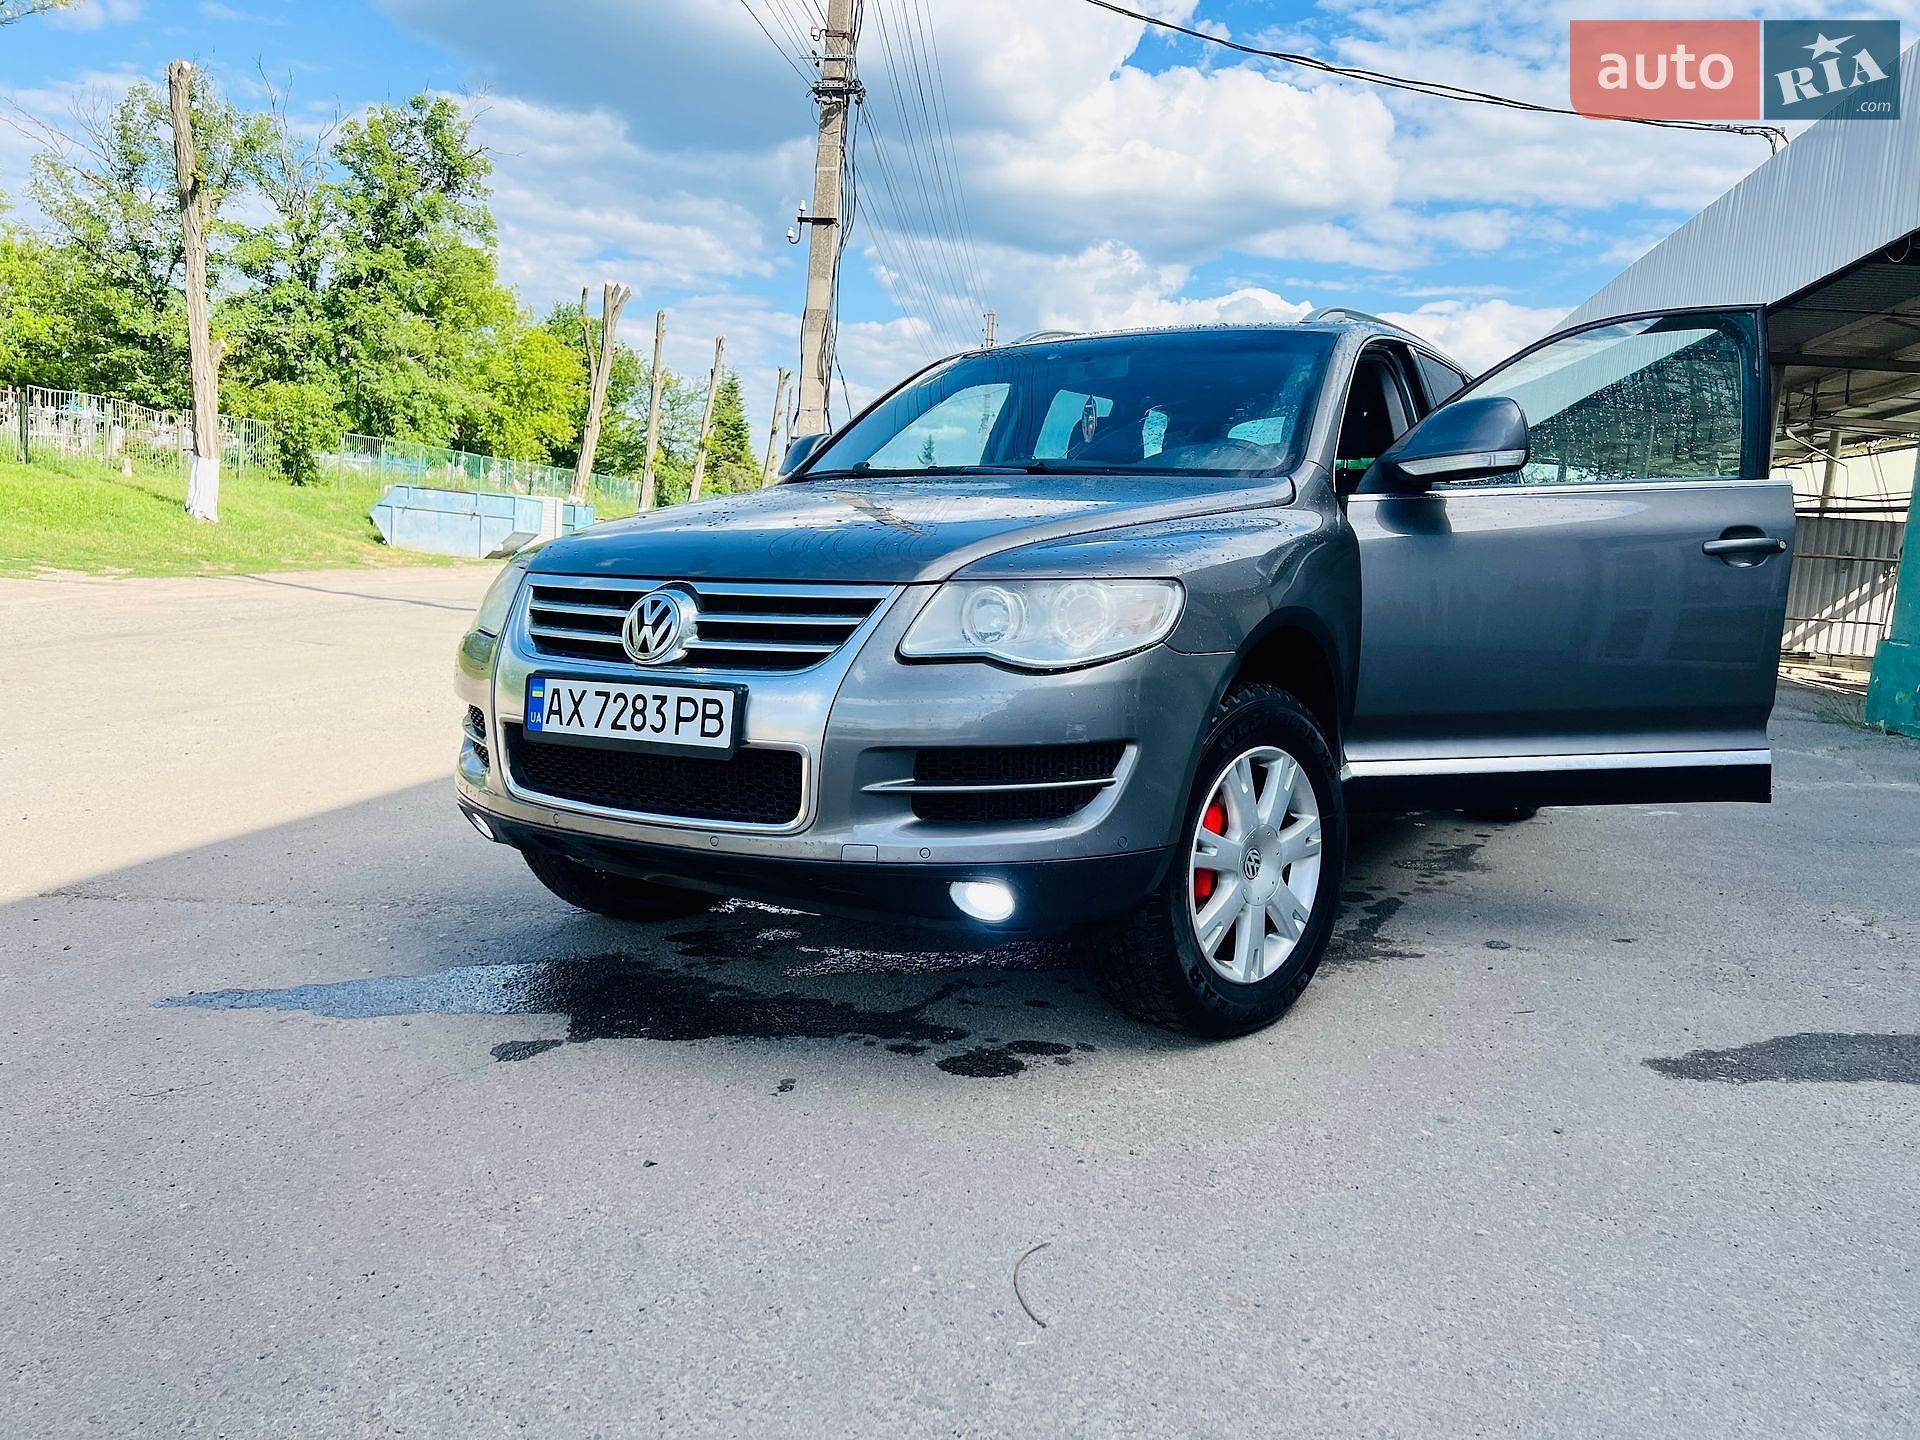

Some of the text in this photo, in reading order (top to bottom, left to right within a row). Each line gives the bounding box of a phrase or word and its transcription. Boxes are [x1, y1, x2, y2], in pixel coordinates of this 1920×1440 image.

[624, 593, 680, 662] VW
[530, 711, 542, 724] UA
[545, 687, 725, 738] AX 7283 PB
